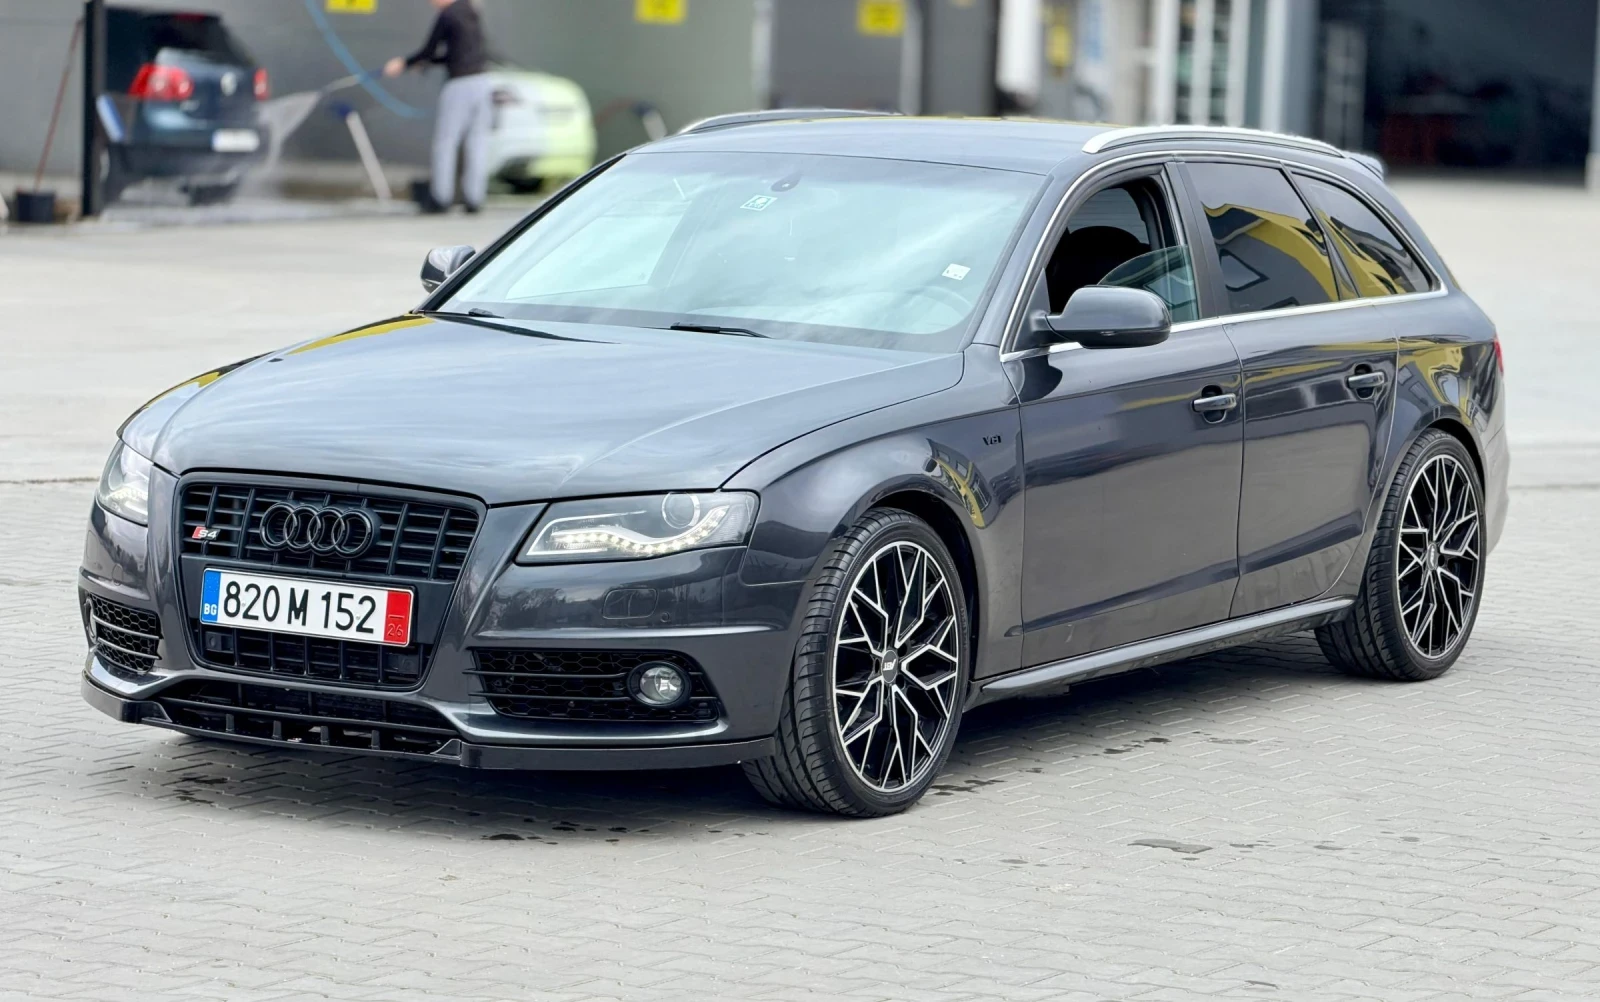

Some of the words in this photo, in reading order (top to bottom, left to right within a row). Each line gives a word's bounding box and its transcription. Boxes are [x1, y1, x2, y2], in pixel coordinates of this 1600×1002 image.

[198, 529, 218, 539] S4
[203, 603, 218, 616] BG
[223, 580, 281, 623] 820
[287, 587, 310, 627] M
[321, 591, 377, 634] 152
[386, 623, 404, 638] 26
